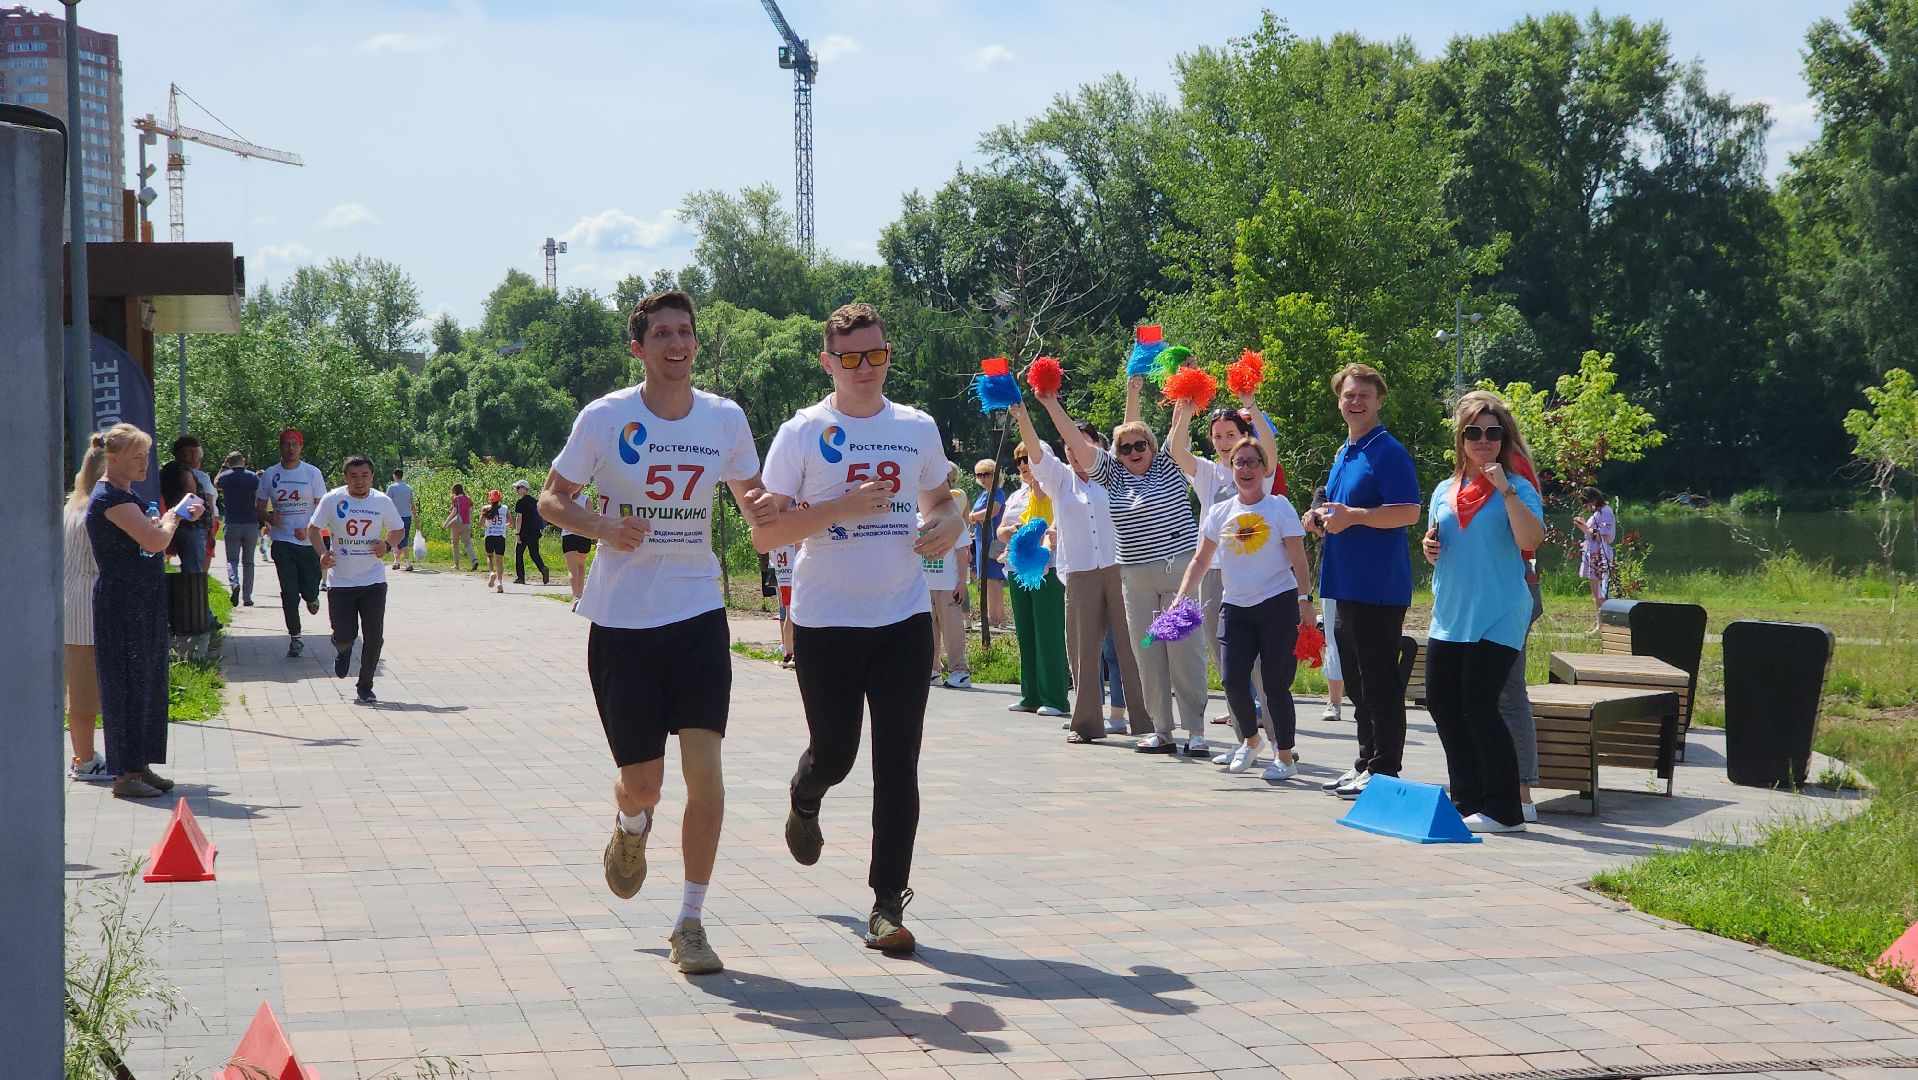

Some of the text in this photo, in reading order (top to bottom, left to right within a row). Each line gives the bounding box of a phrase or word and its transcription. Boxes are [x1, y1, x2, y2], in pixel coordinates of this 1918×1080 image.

[91, 359, 121, 432] OFFEE
[649, 443, 720, 456] Ростелеком
[849, 443, 918, 456] Ростелеком
[644, 464, 705, 501] 57
[846, 460, 901, 494] 58
[277, 489, 301, 502] 24
[636, 506, 707, 519] ПУШКИНО
[492, 515, 503, 525] 95
[345, 518, 373, 537] 67
